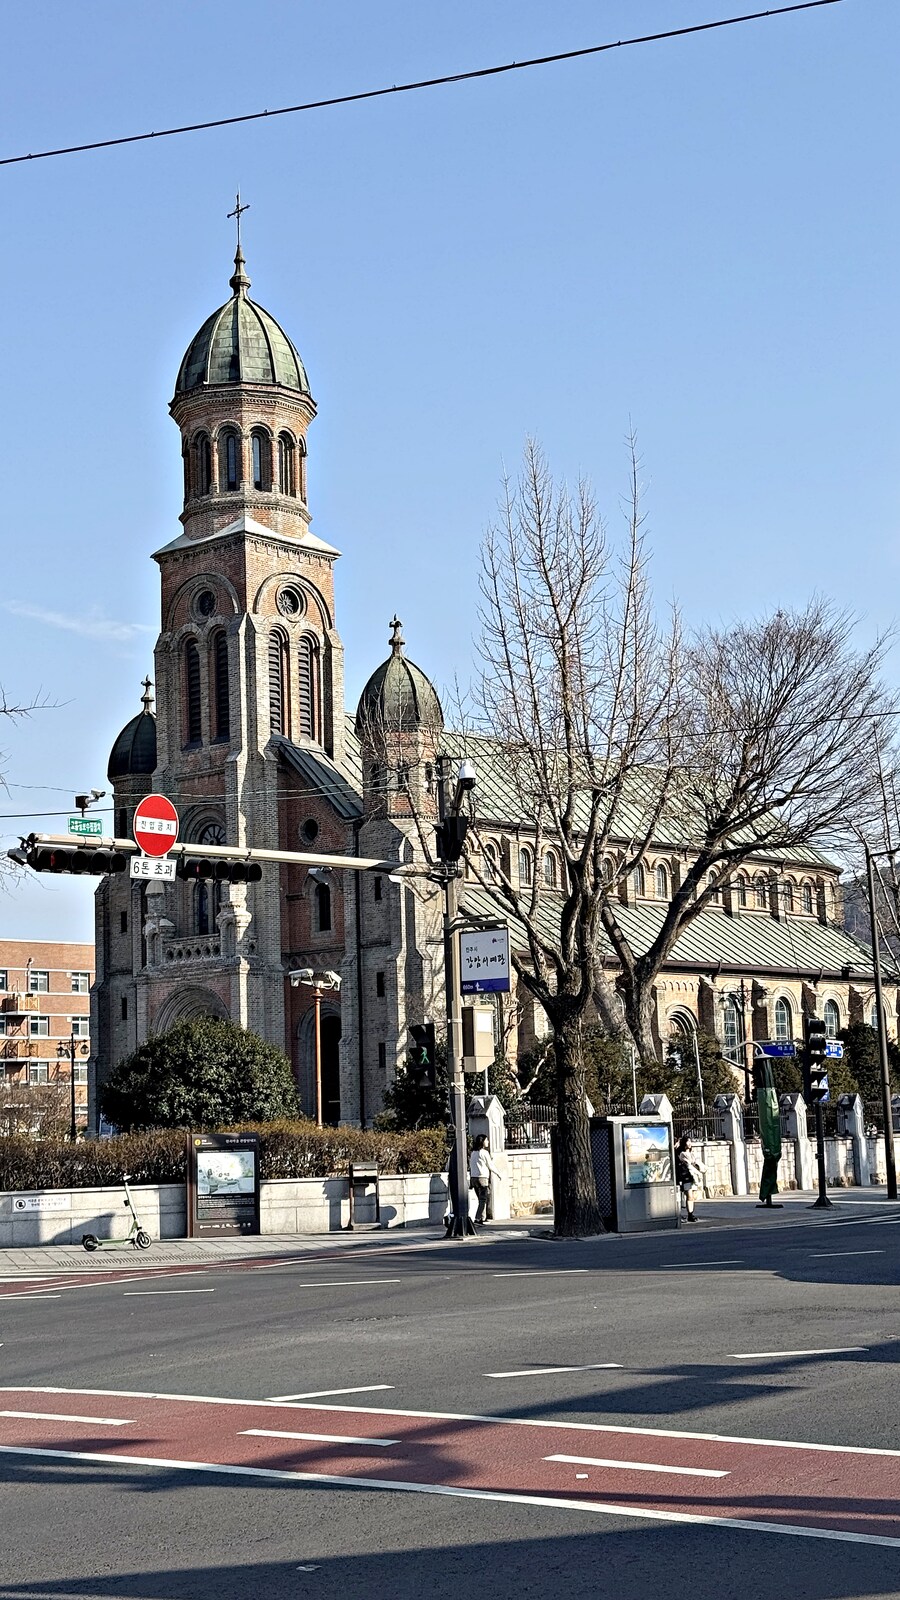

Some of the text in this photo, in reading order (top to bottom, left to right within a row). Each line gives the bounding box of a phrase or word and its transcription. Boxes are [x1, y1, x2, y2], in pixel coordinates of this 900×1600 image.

[141, 820, 172, 832] 진입금지
[133, 861, 172, 876] 6톤 초과
[466, 953, 505, 968] 강암서예관
